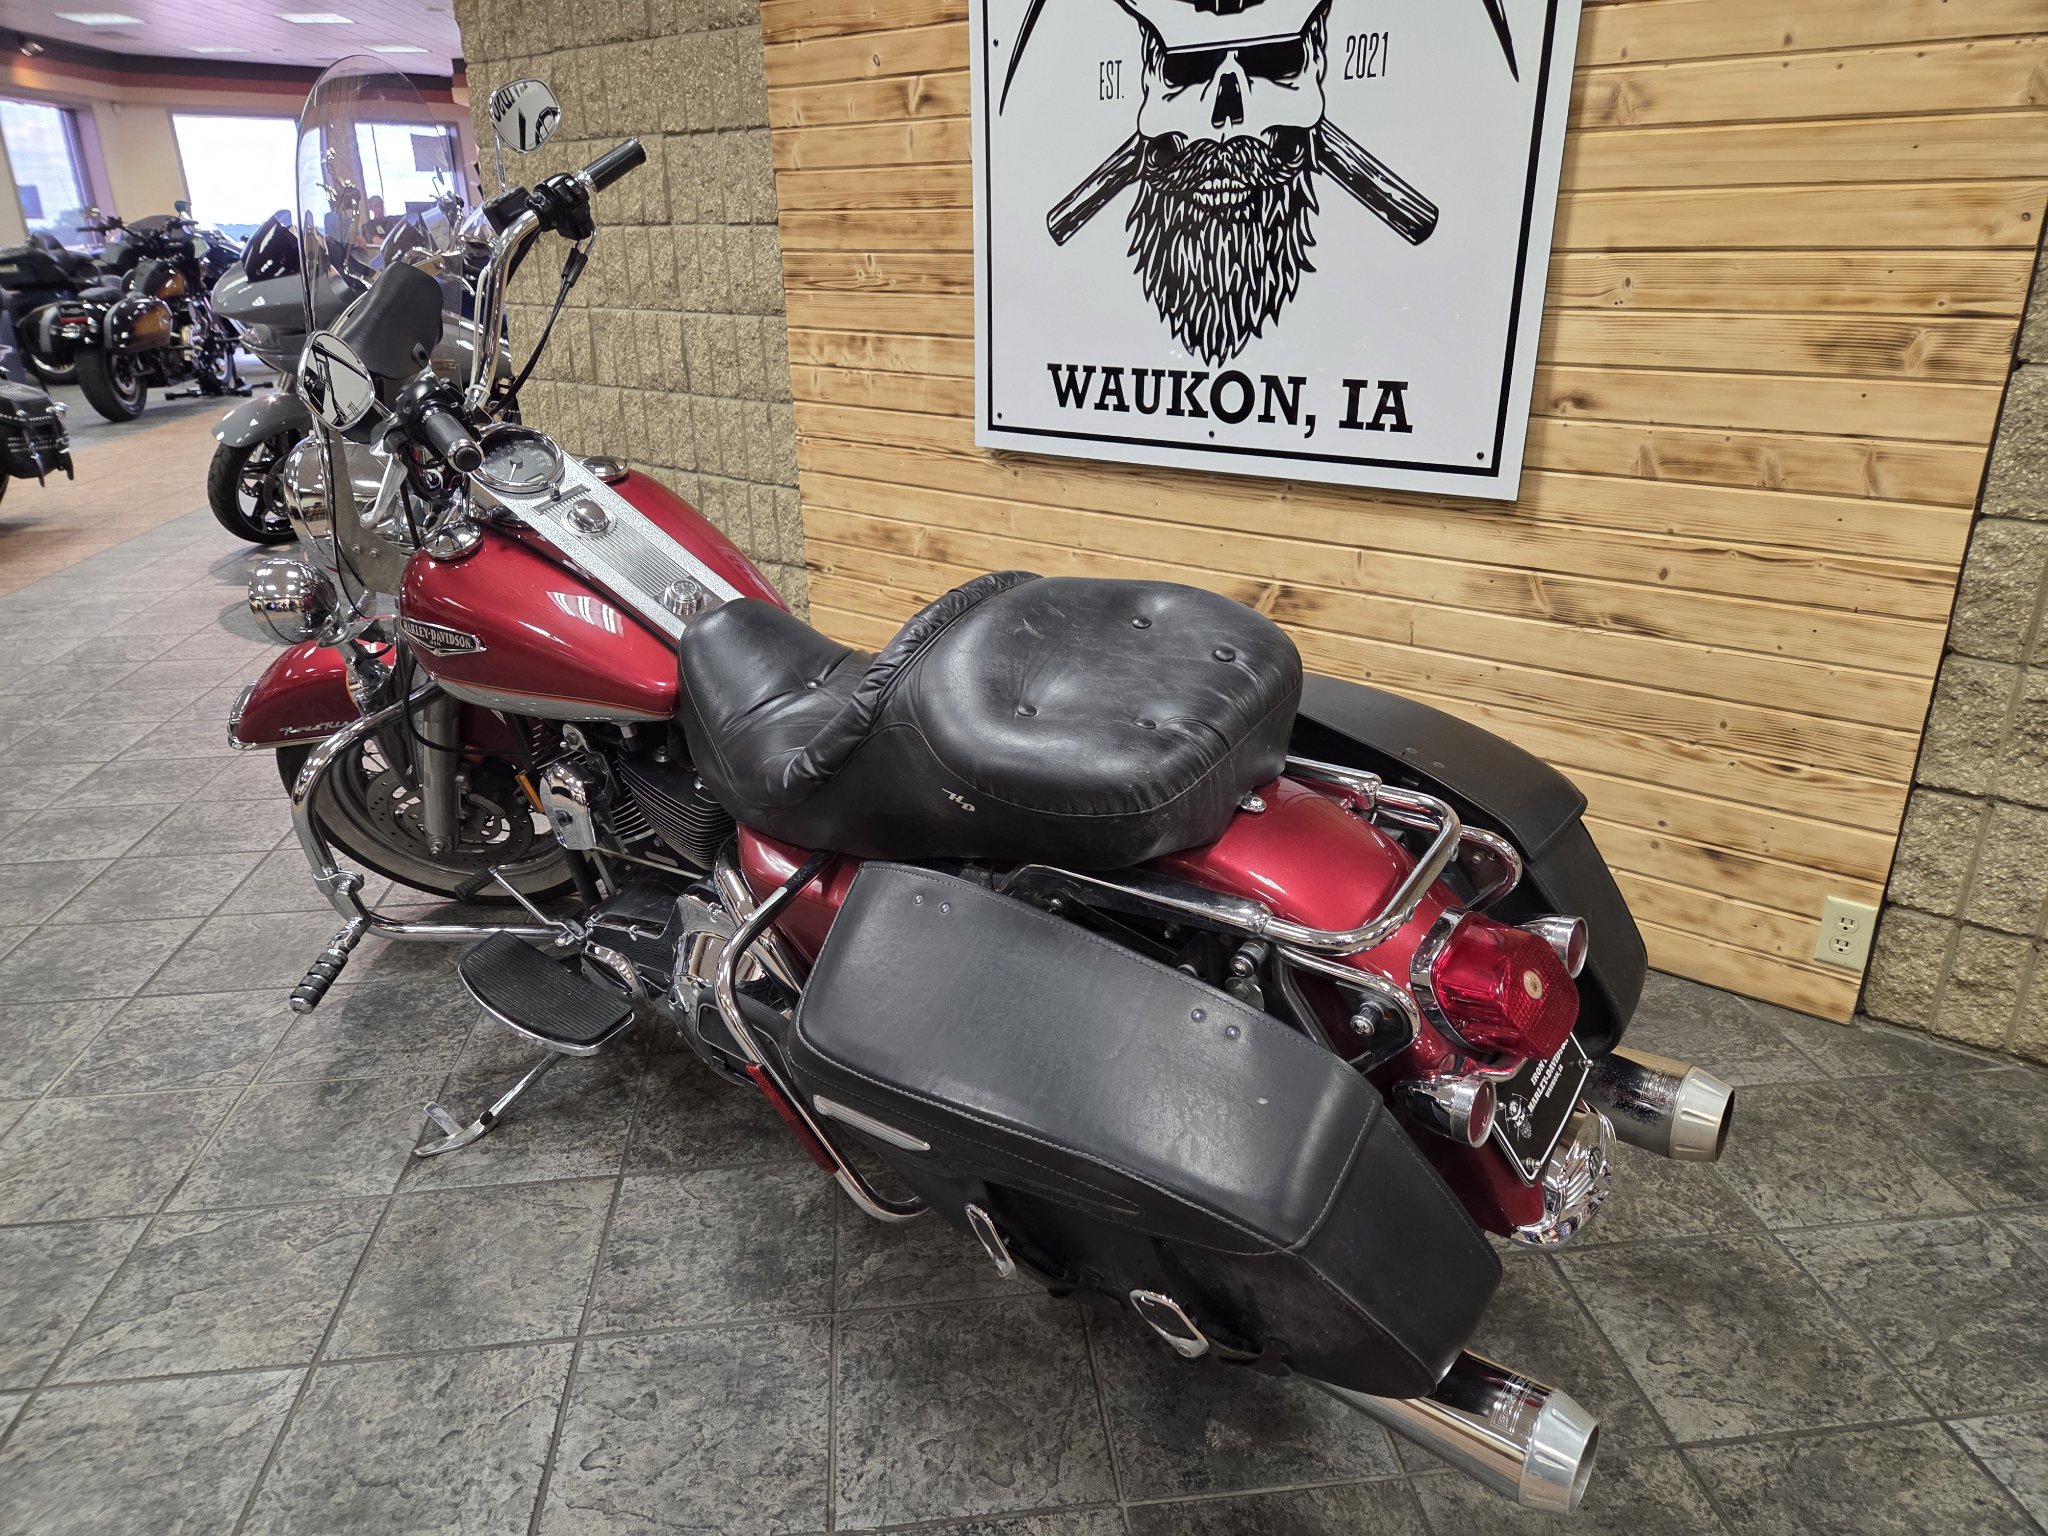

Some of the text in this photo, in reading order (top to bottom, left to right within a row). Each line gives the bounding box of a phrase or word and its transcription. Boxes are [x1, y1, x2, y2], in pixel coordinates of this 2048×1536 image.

[1099, 31, 1389, 101] EST. 2021
[1047, 362, 1414, 439] WAUKON, IA
